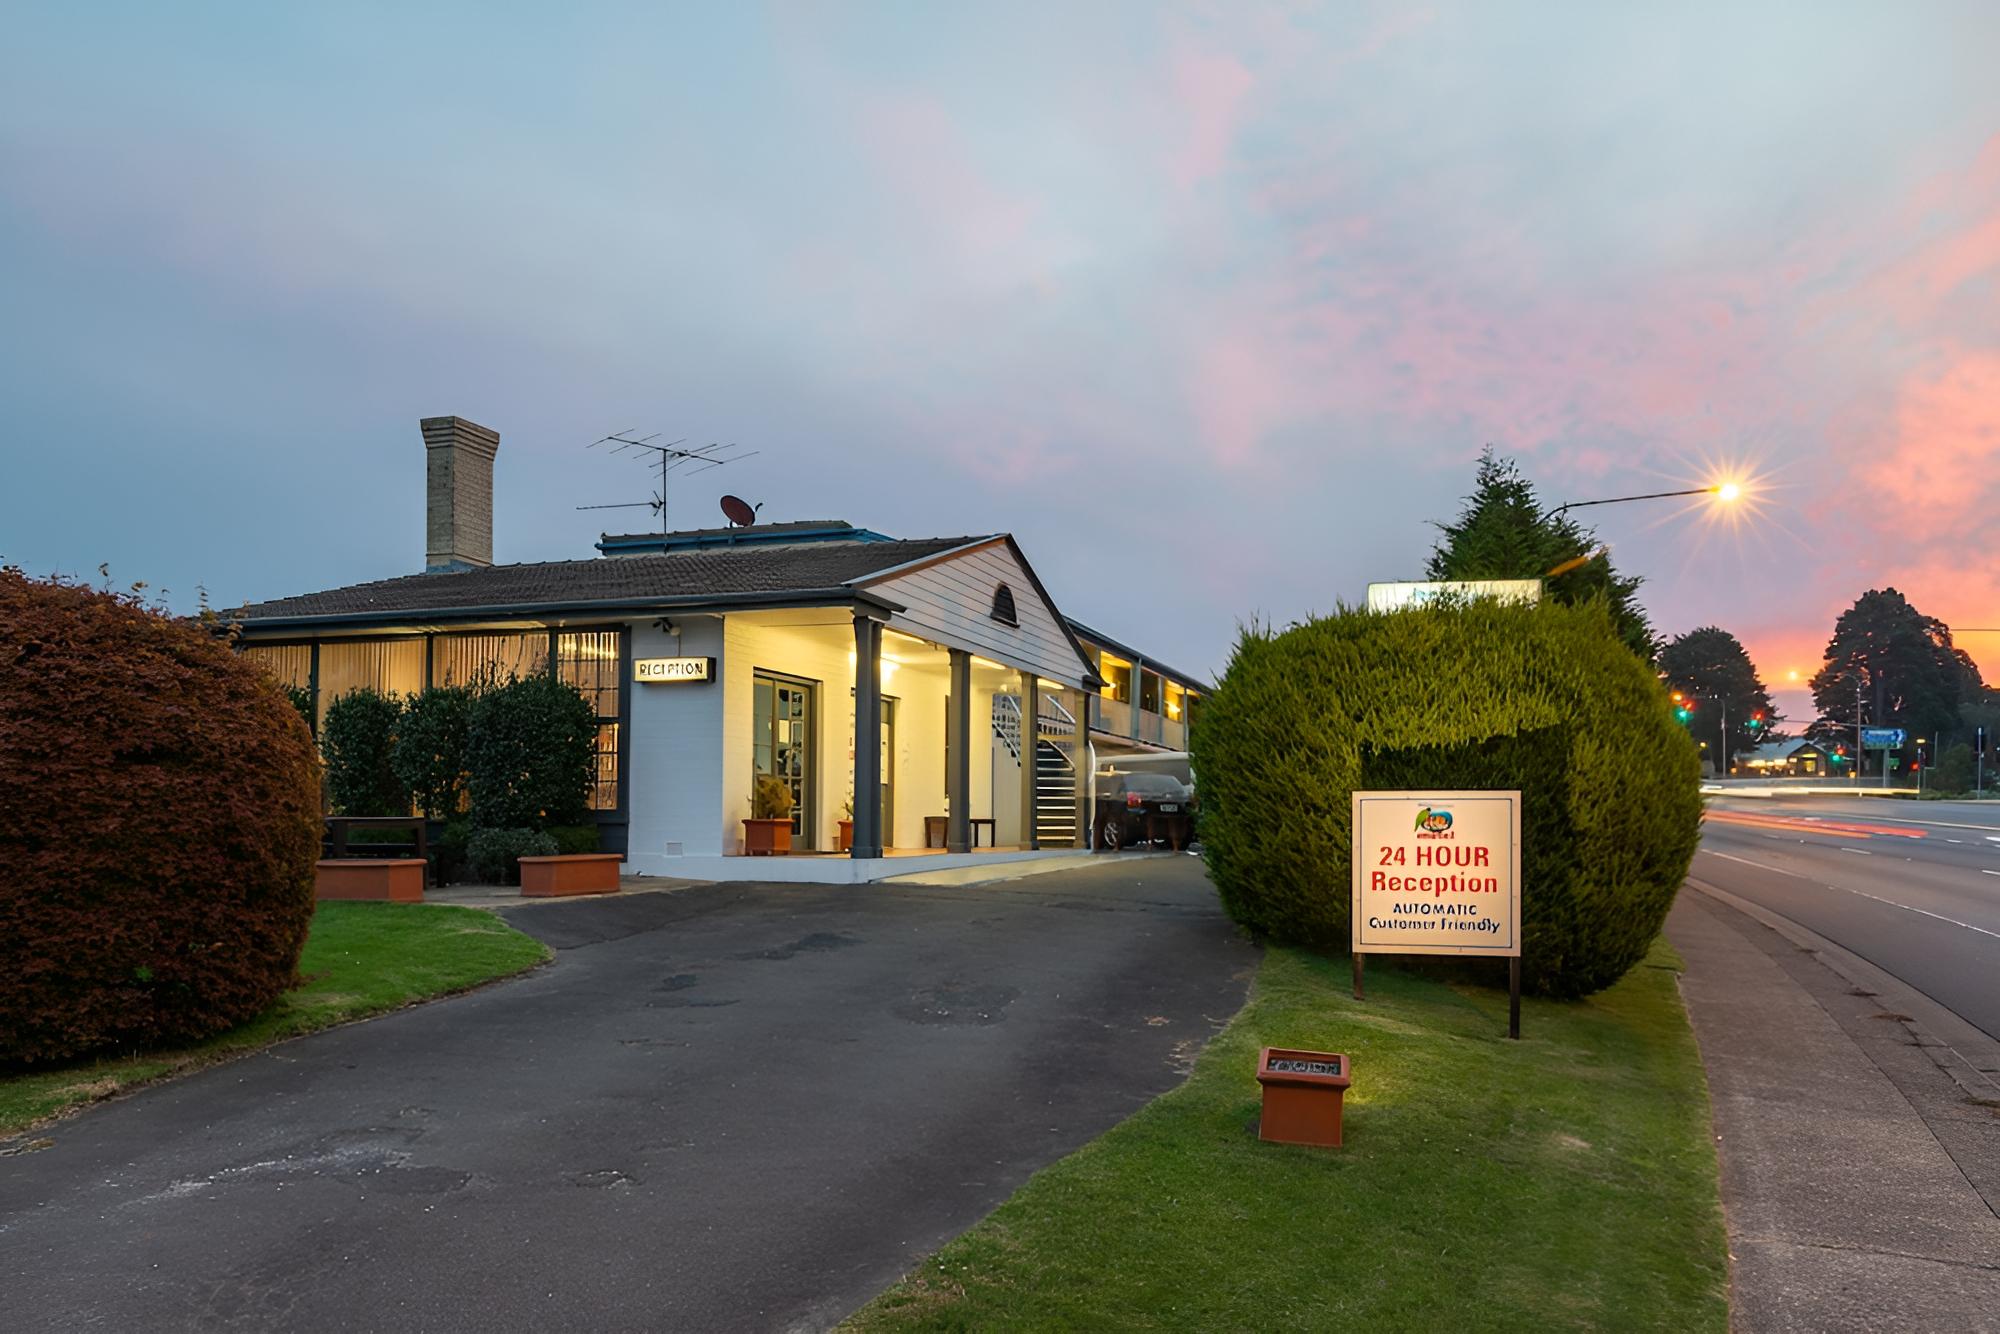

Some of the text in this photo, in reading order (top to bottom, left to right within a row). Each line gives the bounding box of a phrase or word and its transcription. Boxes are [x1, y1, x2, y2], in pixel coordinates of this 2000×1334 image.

[1379, 846, 1489, 867] 24 HOUR
[1371, 871, 1498, 898] Reception
[1393, 903, 1477, 915] AUTOMATIC
